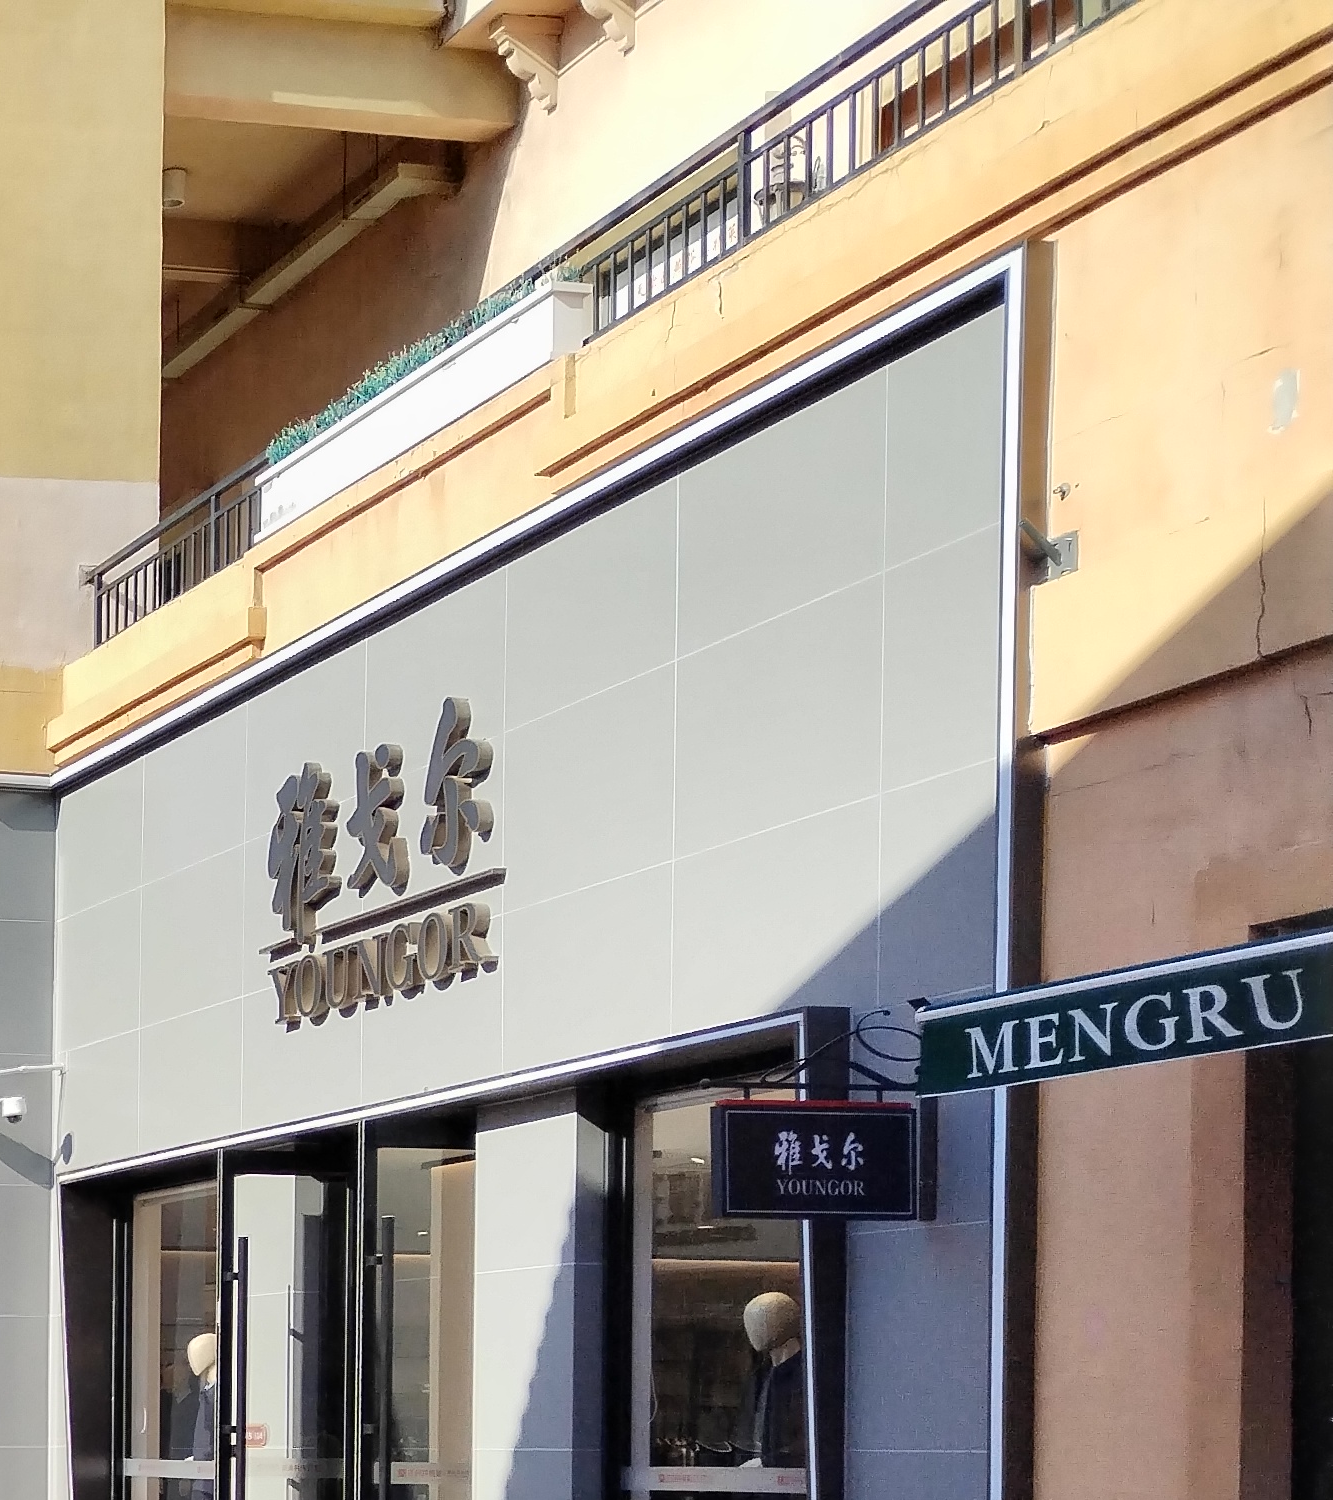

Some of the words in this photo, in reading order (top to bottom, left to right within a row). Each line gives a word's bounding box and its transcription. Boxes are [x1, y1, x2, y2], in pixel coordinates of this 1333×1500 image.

[268, 697, 495, 951] 雅戈尔
[267, 902, 499, 1026] YOUNGOR
[965, 970, 1307, 1080] MENGRU
[773, 1130, 866, 1174] 雅戈尔
[776, 1178, 865, 1197] YOUNGOR
